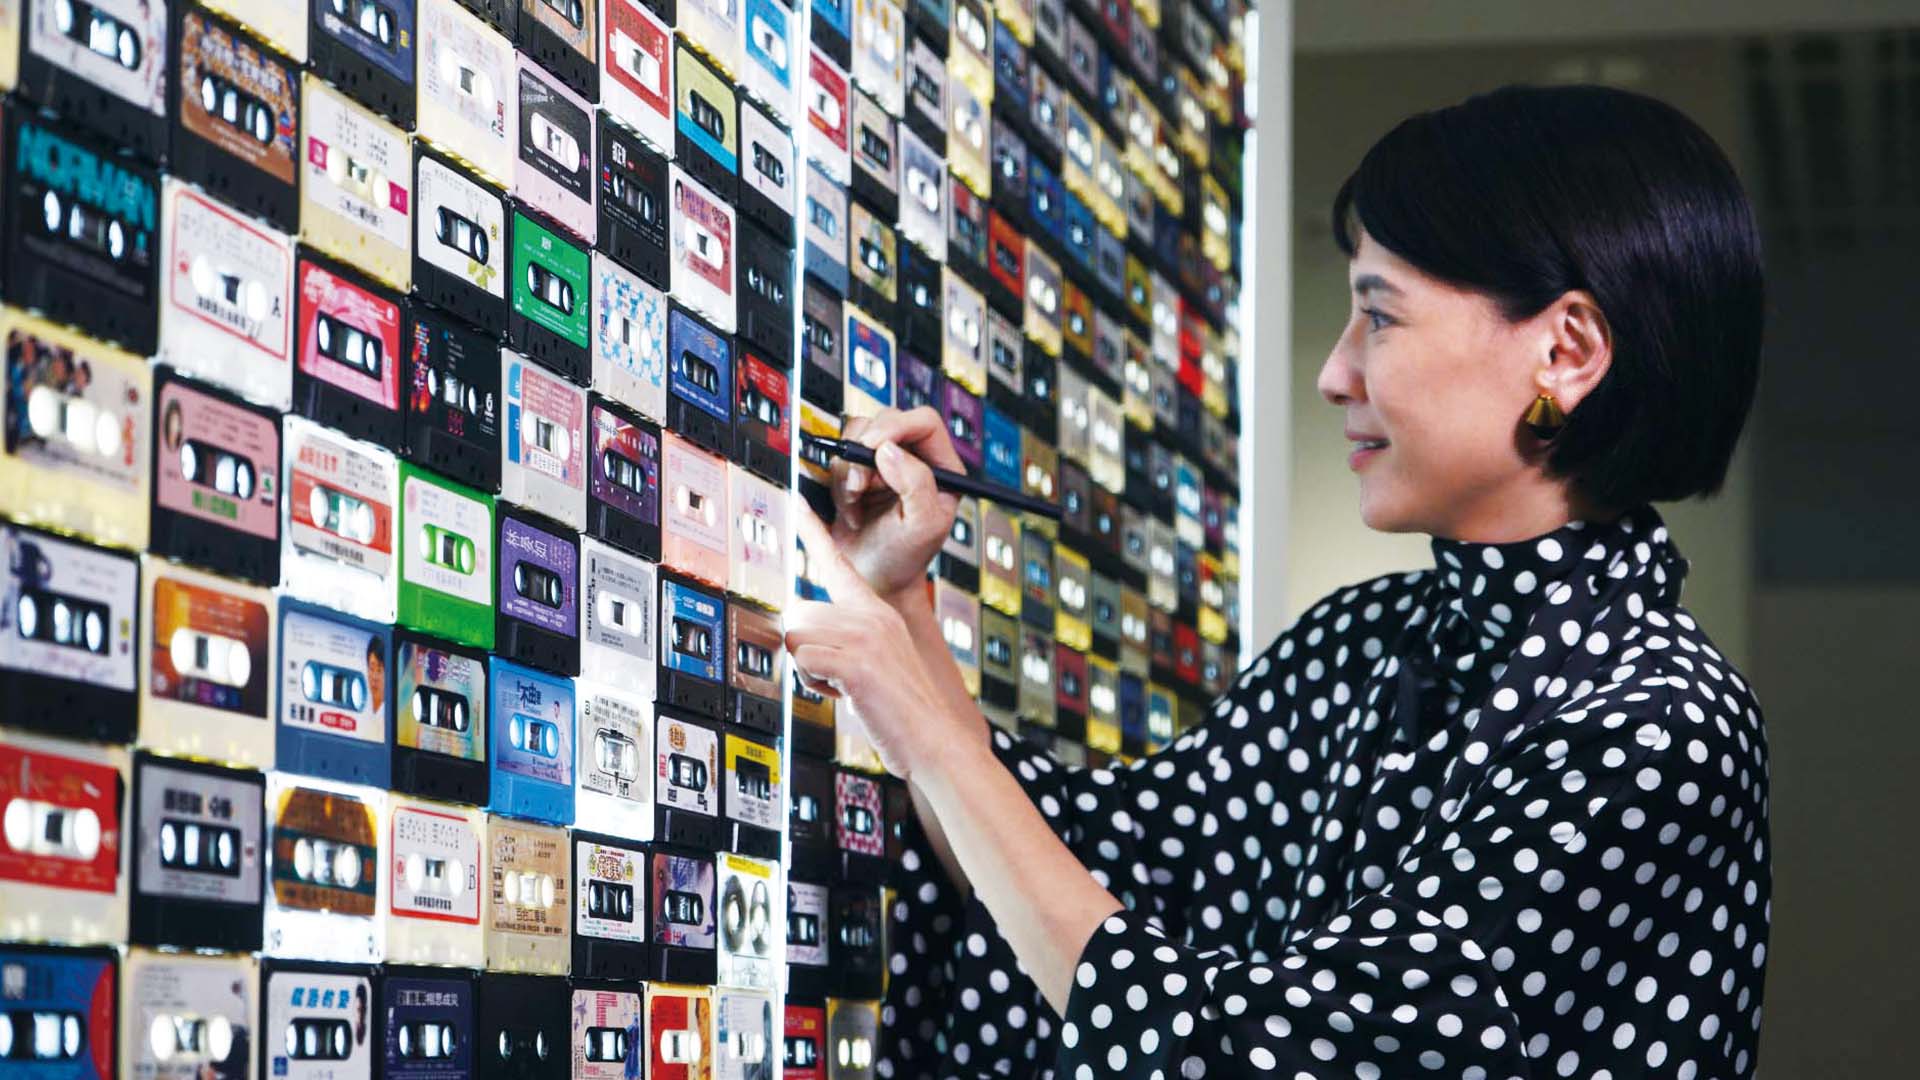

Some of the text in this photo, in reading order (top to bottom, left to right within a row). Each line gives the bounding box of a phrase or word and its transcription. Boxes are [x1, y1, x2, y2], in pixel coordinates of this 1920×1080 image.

[17, 122, 154, 231] NORMAN
[271, 295, 282, 318] A
[468, 864, 476, 890] B
